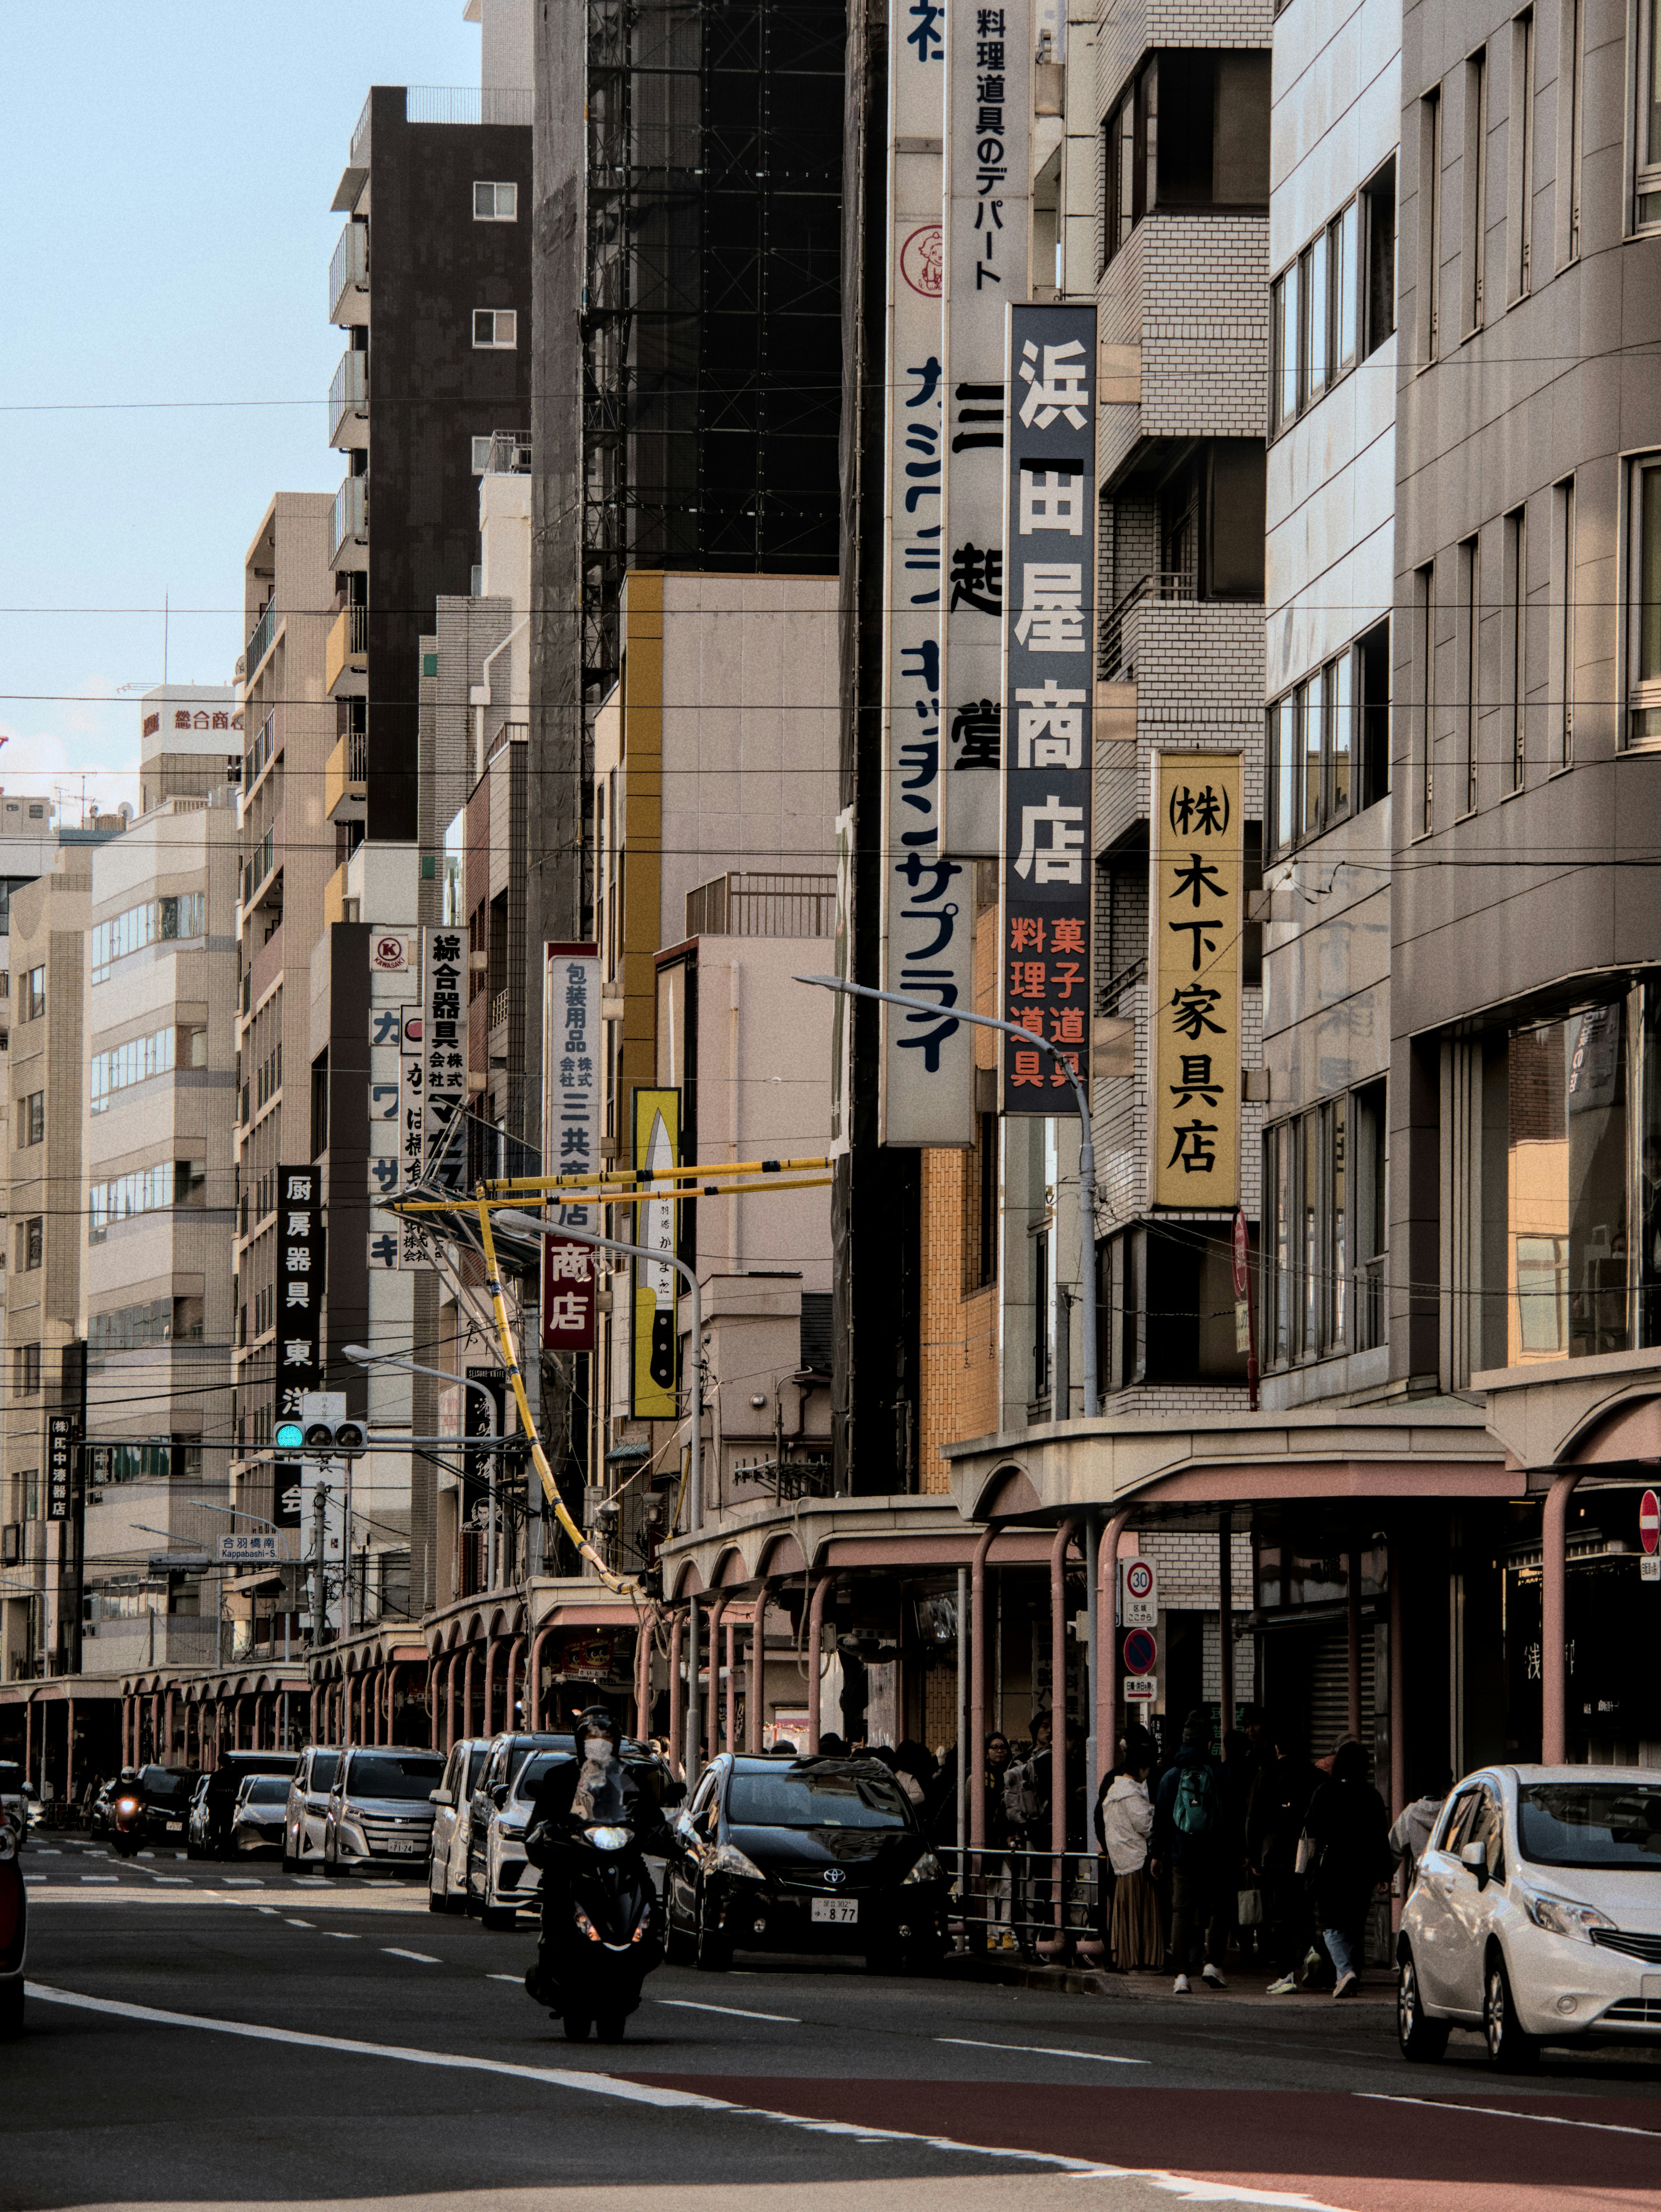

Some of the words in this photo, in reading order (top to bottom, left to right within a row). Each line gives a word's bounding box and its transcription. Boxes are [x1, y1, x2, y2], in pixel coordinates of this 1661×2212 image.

[974, 9, 1007, 290] 料理道具のデパート
[1013, 339, 1088, 884] 浜田屋商店
[374, 957, 405, 969] KAWASAKI
[382, 943, 397, 956] K
[1010, 917, 1046, 1088] 料理道具
[1050, 917, 1086, 1088] 菓子道具
[1167, 784, 1230, 1174] (株)木下家具店
[565, 963, 587, 1053] 包装用品
[285, 1176, 312, 1308] 厨房器具
[550, 1243, 590, 1330] 商店
[281, 1338, 313, 1515] 東洋会
[468, 1369, 488, 1378] SEISUKE
[490, 1369, 505, 1378] KNIFE
[223, 1537, 275, 1549] 合羽橋南
[1133, 1572, 1147, 1588] 30
